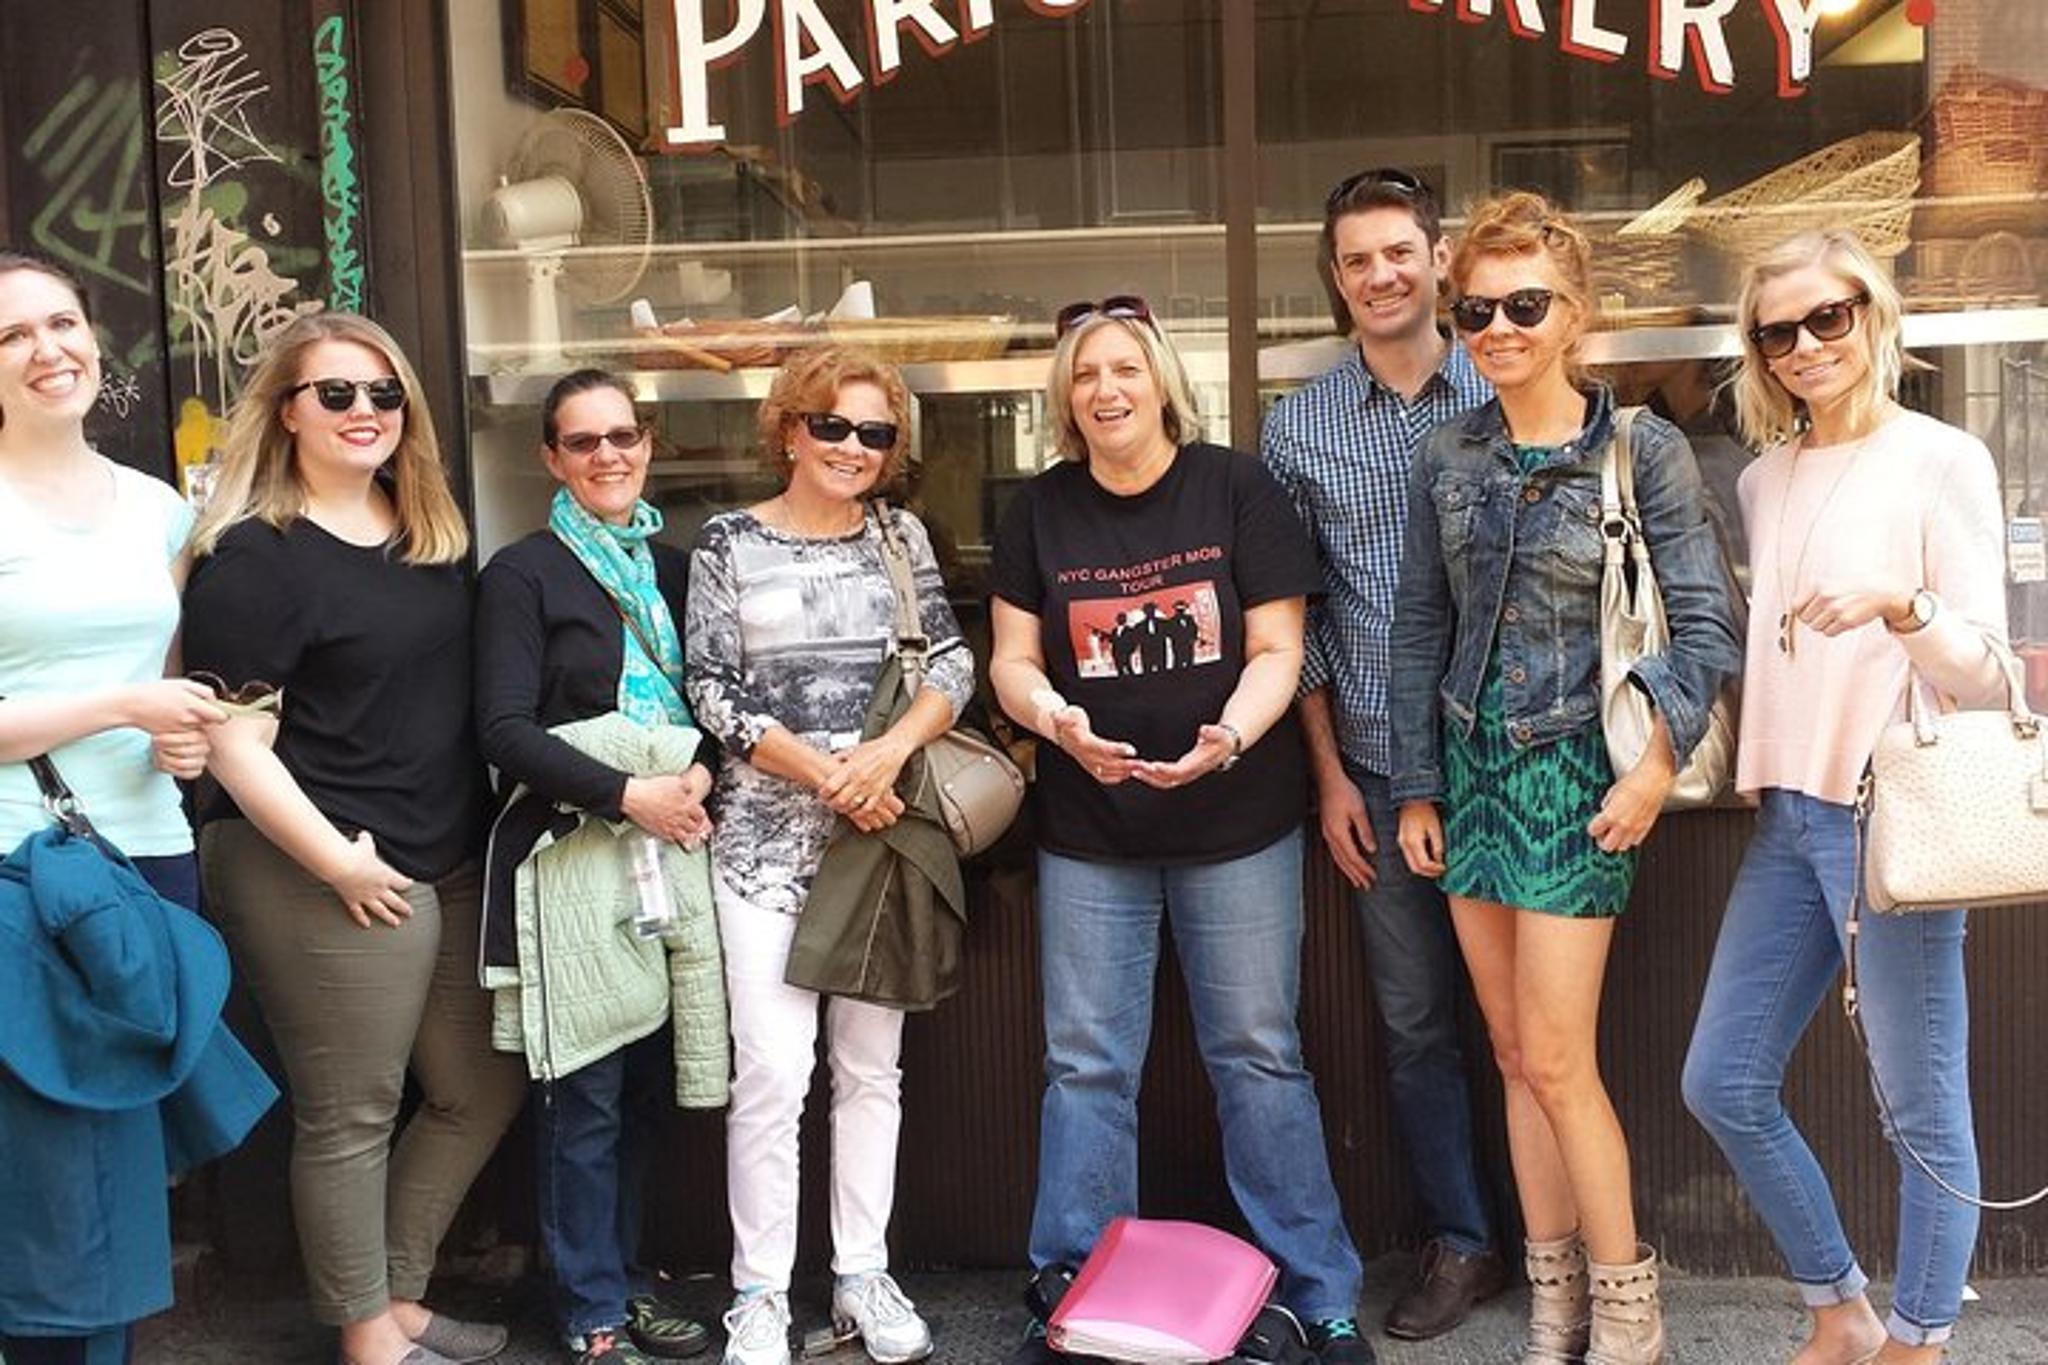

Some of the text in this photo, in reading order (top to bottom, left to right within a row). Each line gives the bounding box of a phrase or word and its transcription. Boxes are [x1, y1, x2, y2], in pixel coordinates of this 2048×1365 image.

[663, 0, 1090, 149] PAR
[1057, 546, 1222, 584] NYC GANGSTER MOB
[1120, 574, 1164, 594] TOUR
